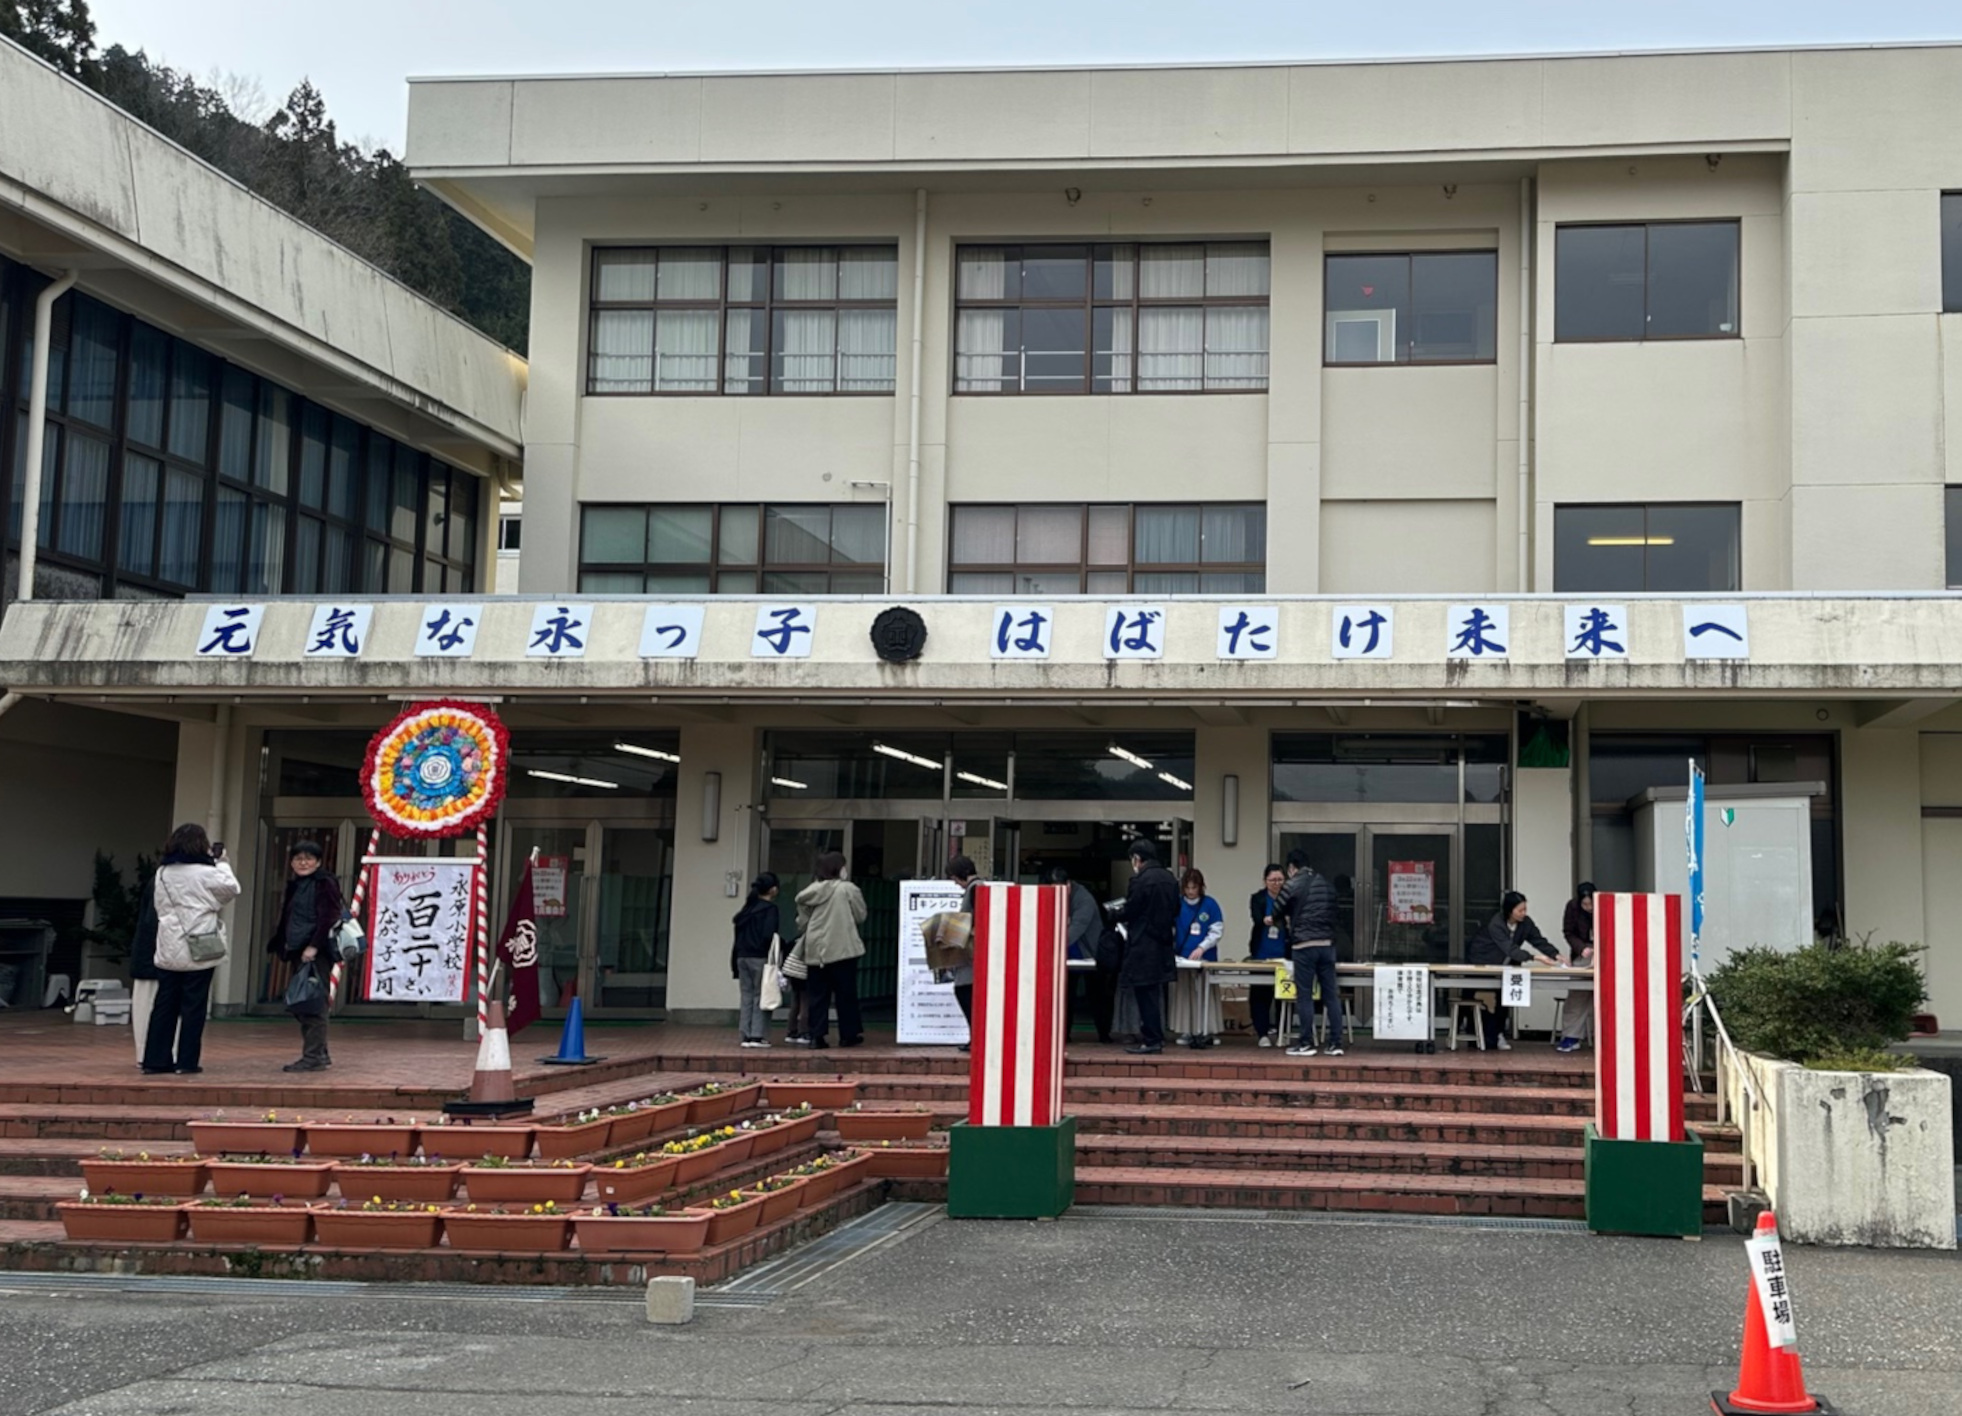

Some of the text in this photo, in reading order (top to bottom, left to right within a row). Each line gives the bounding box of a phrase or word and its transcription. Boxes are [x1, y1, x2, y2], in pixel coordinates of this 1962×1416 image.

[202, 607, 1742, 654] 元気な永っ子 はばたけ未来へ
[443, 872, 469, 971] 永原小学校
[919, 899, 962, 910] キンシロ
[401, 890, 442, 996] 百二十さい
[1510, 974, 1523, 1001] 受付
[1762, 1250, 1791, 1324] 駐車場
